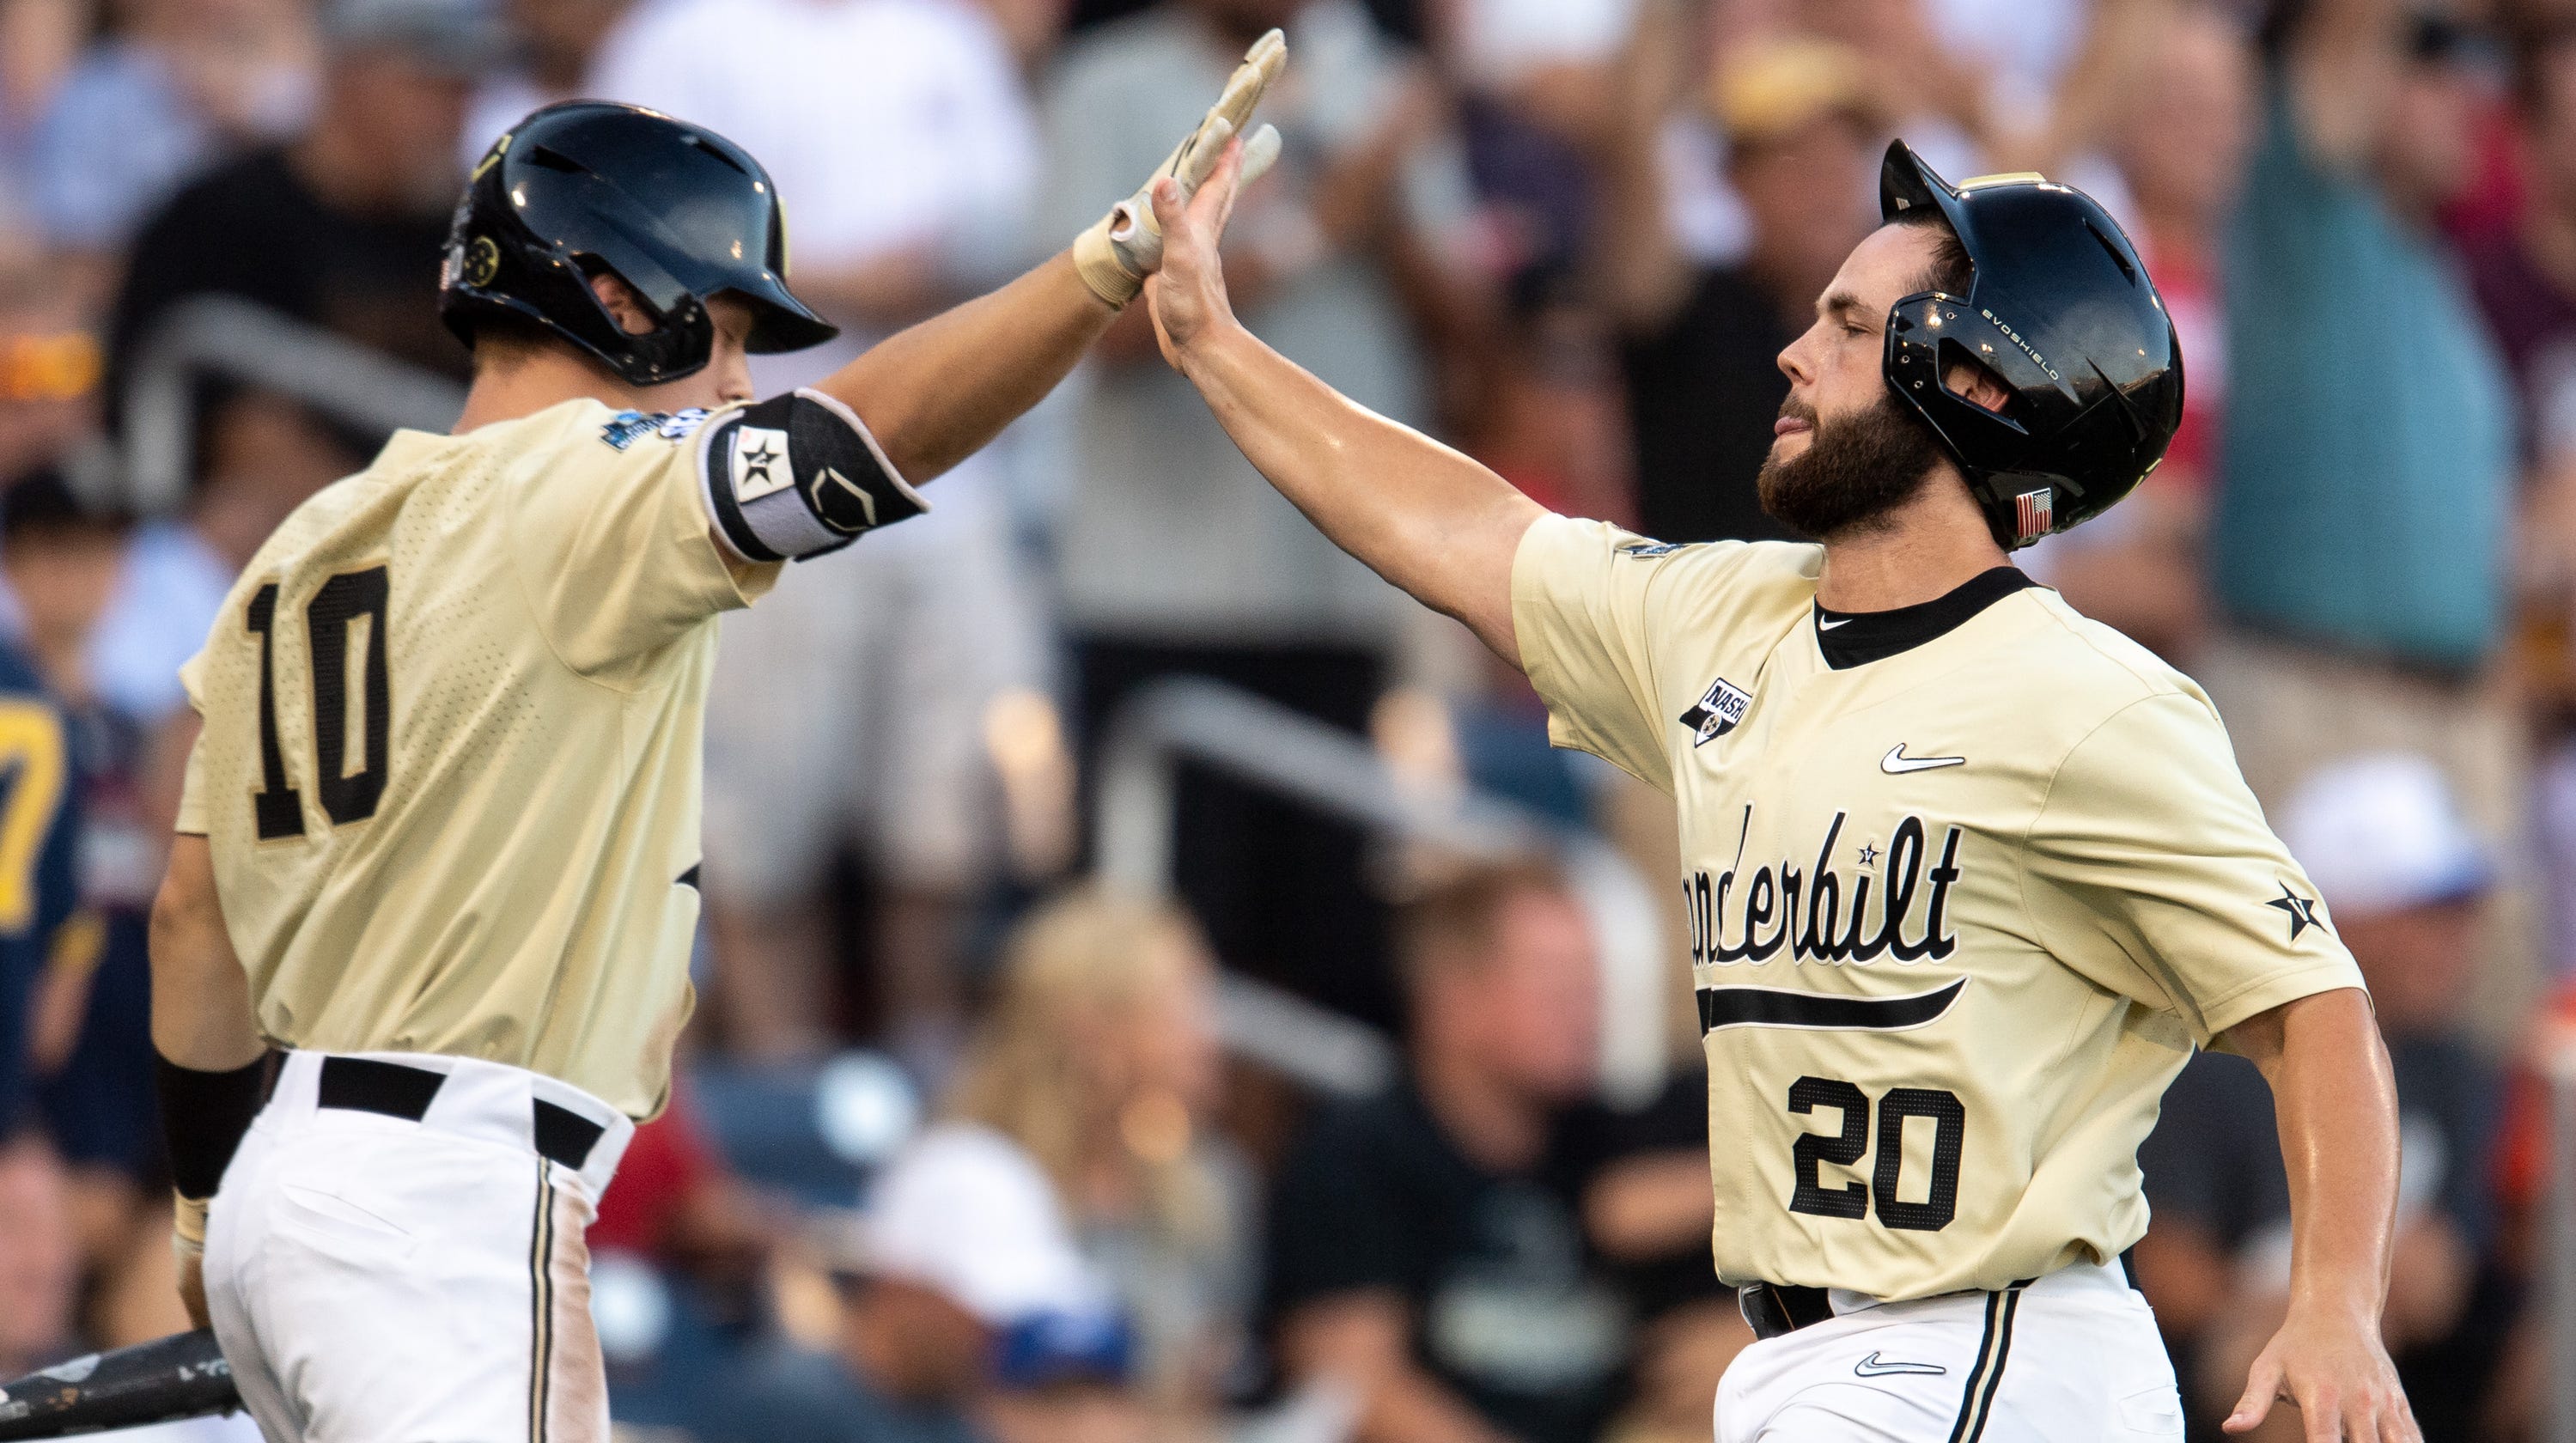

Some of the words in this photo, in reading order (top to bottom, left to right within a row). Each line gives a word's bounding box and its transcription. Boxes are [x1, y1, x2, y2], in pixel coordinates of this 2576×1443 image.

[1982, 308, 2059, 381] EVOSHIELD
[247, 564, 390, 842] 10
[1704, 685, 1748, 720] NASH
[2287, 898, 2310, 922] V
[1788, 1075, 1965, 1232] 20
